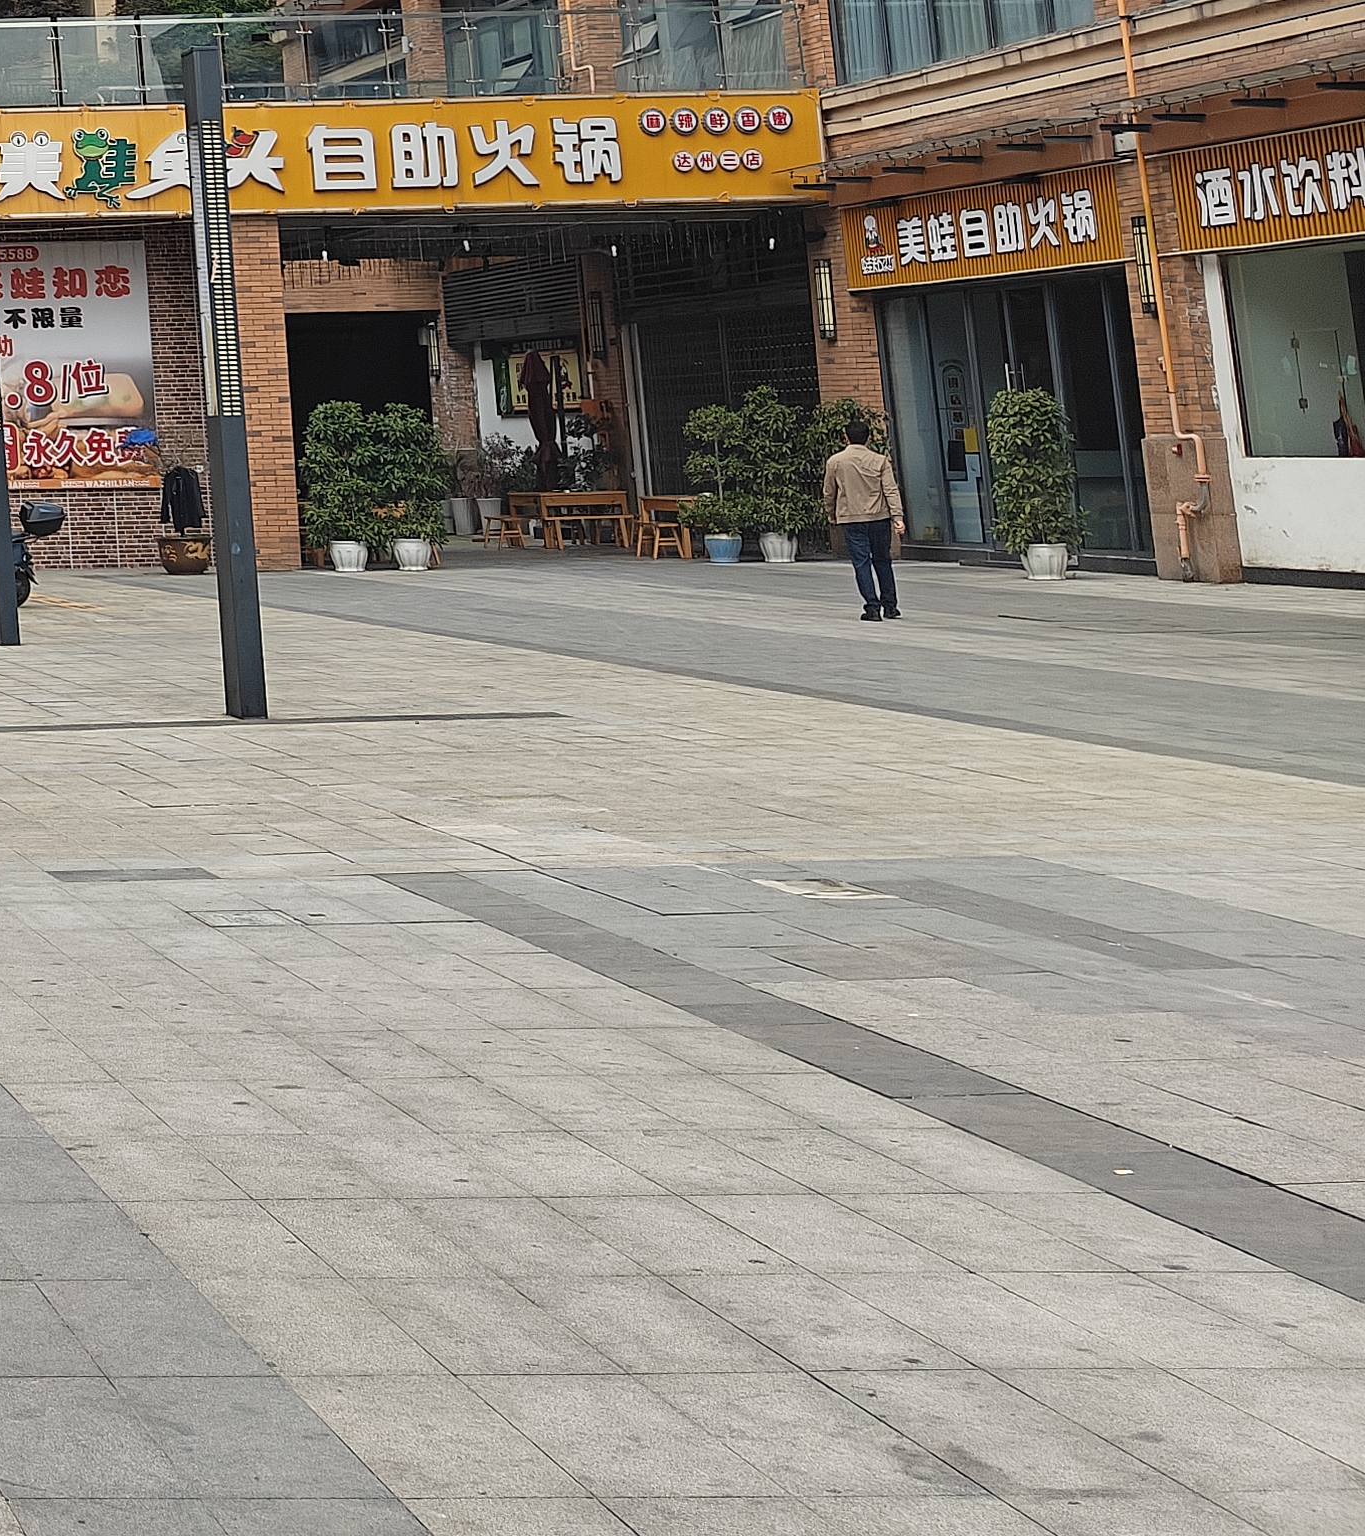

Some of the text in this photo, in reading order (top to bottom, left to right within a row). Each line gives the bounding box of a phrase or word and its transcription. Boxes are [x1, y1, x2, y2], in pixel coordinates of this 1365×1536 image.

[676, 152, 760, 168] 达州三店
[1194, 147, 1365, 227] 酒水饮料
[896, 189, 1098, 266] 美蛙自助火锅
